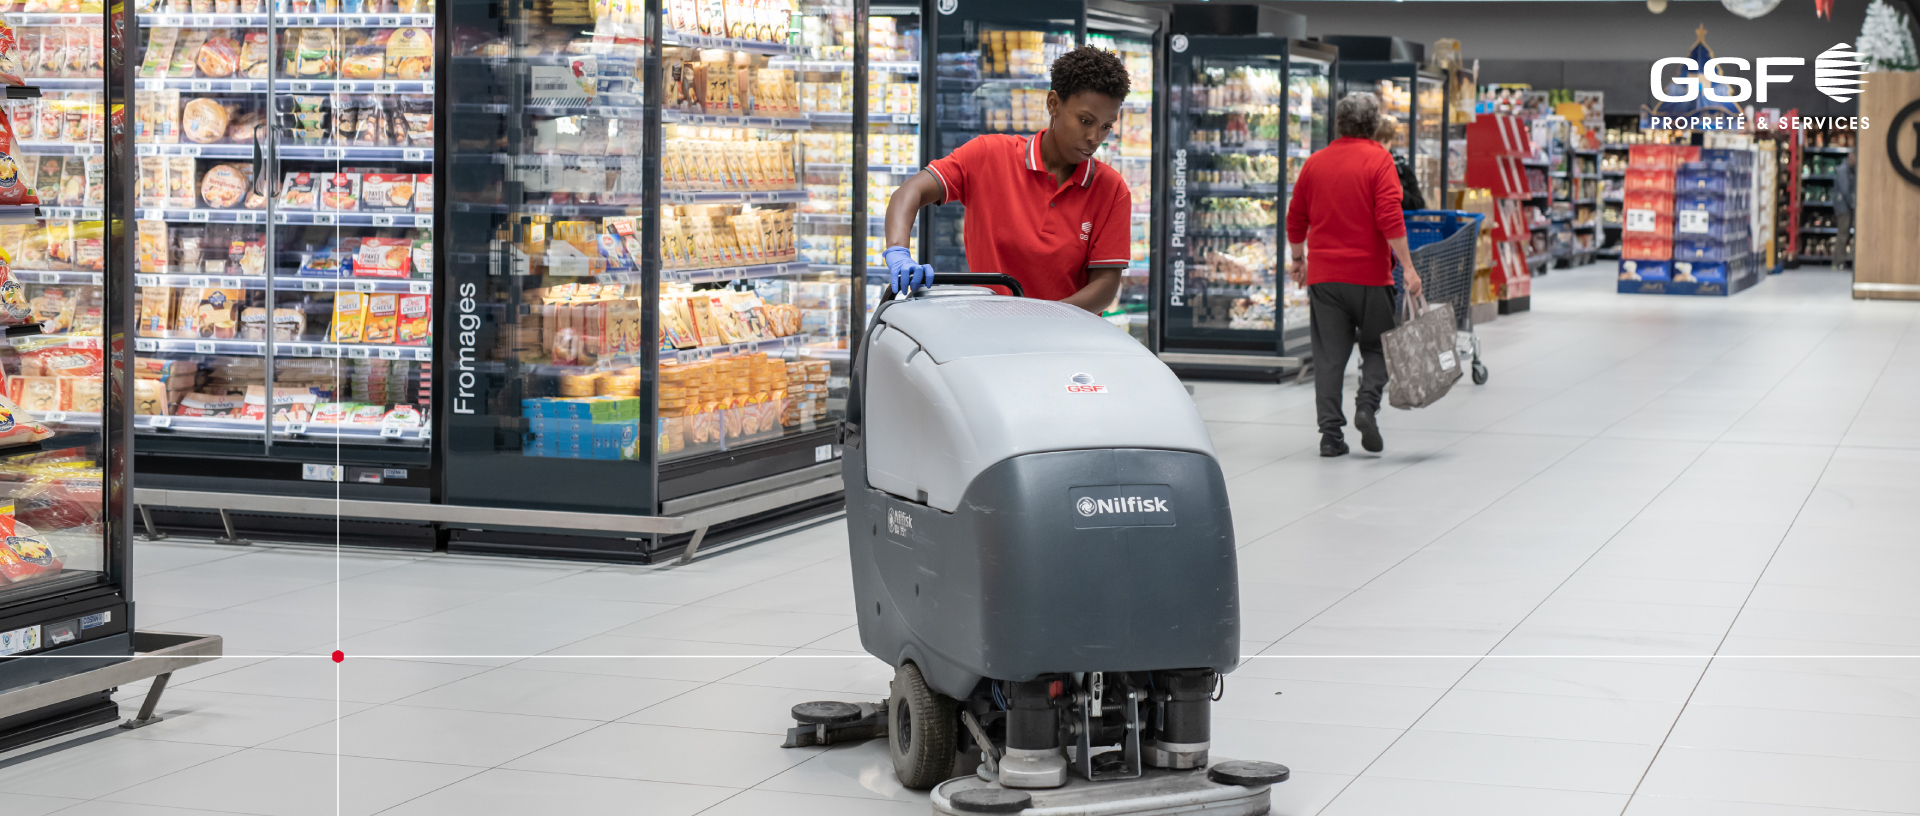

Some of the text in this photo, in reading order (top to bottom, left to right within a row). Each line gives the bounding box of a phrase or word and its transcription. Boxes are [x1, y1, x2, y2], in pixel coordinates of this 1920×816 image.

[1173, 149, 1188, 209] cuisinés
[1172, 211, 1186, 248] Plats
[1171, 260, 1185, 307] Pizzas
[371, 303, 393, 311] CHEESE
[402, 305, 423, 313] CHEESE
[453, 282, 482, 415] Fromages
[1067, 385, 1105, 393] GSF
[1097, 496, 1169, 514] Nilfisk
[894, 510, 913, 528] Nilfisk
